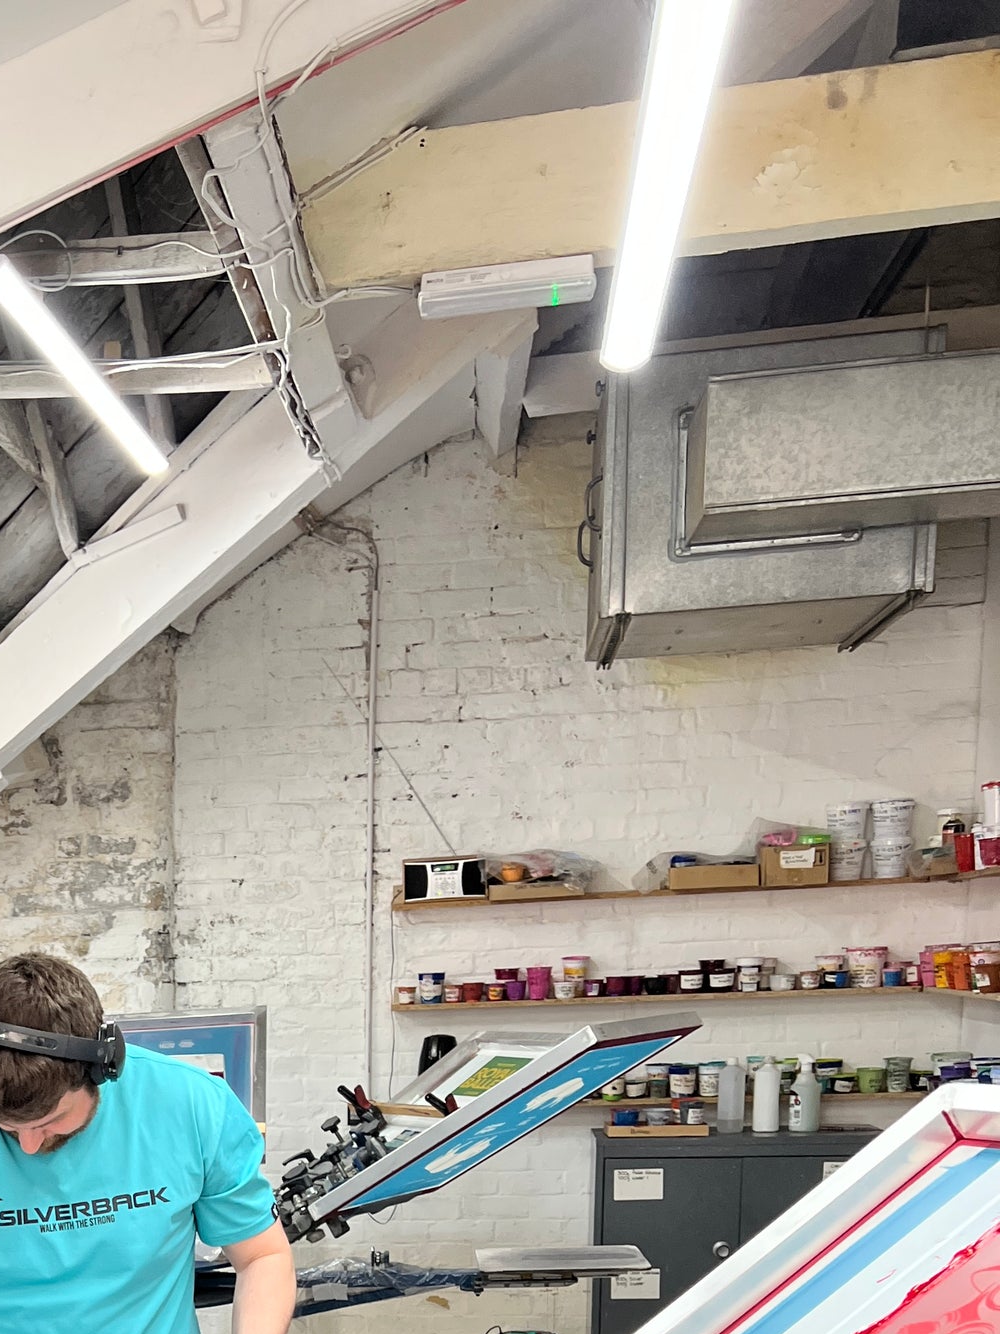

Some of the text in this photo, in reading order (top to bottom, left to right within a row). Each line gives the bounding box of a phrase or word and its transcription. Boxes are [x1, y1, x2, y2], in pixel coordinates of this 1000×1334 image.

[0, 1187, 171, 1226] SILVERBACK
[39, 1215, 116, 1233] WALK WITH THE STRONG
